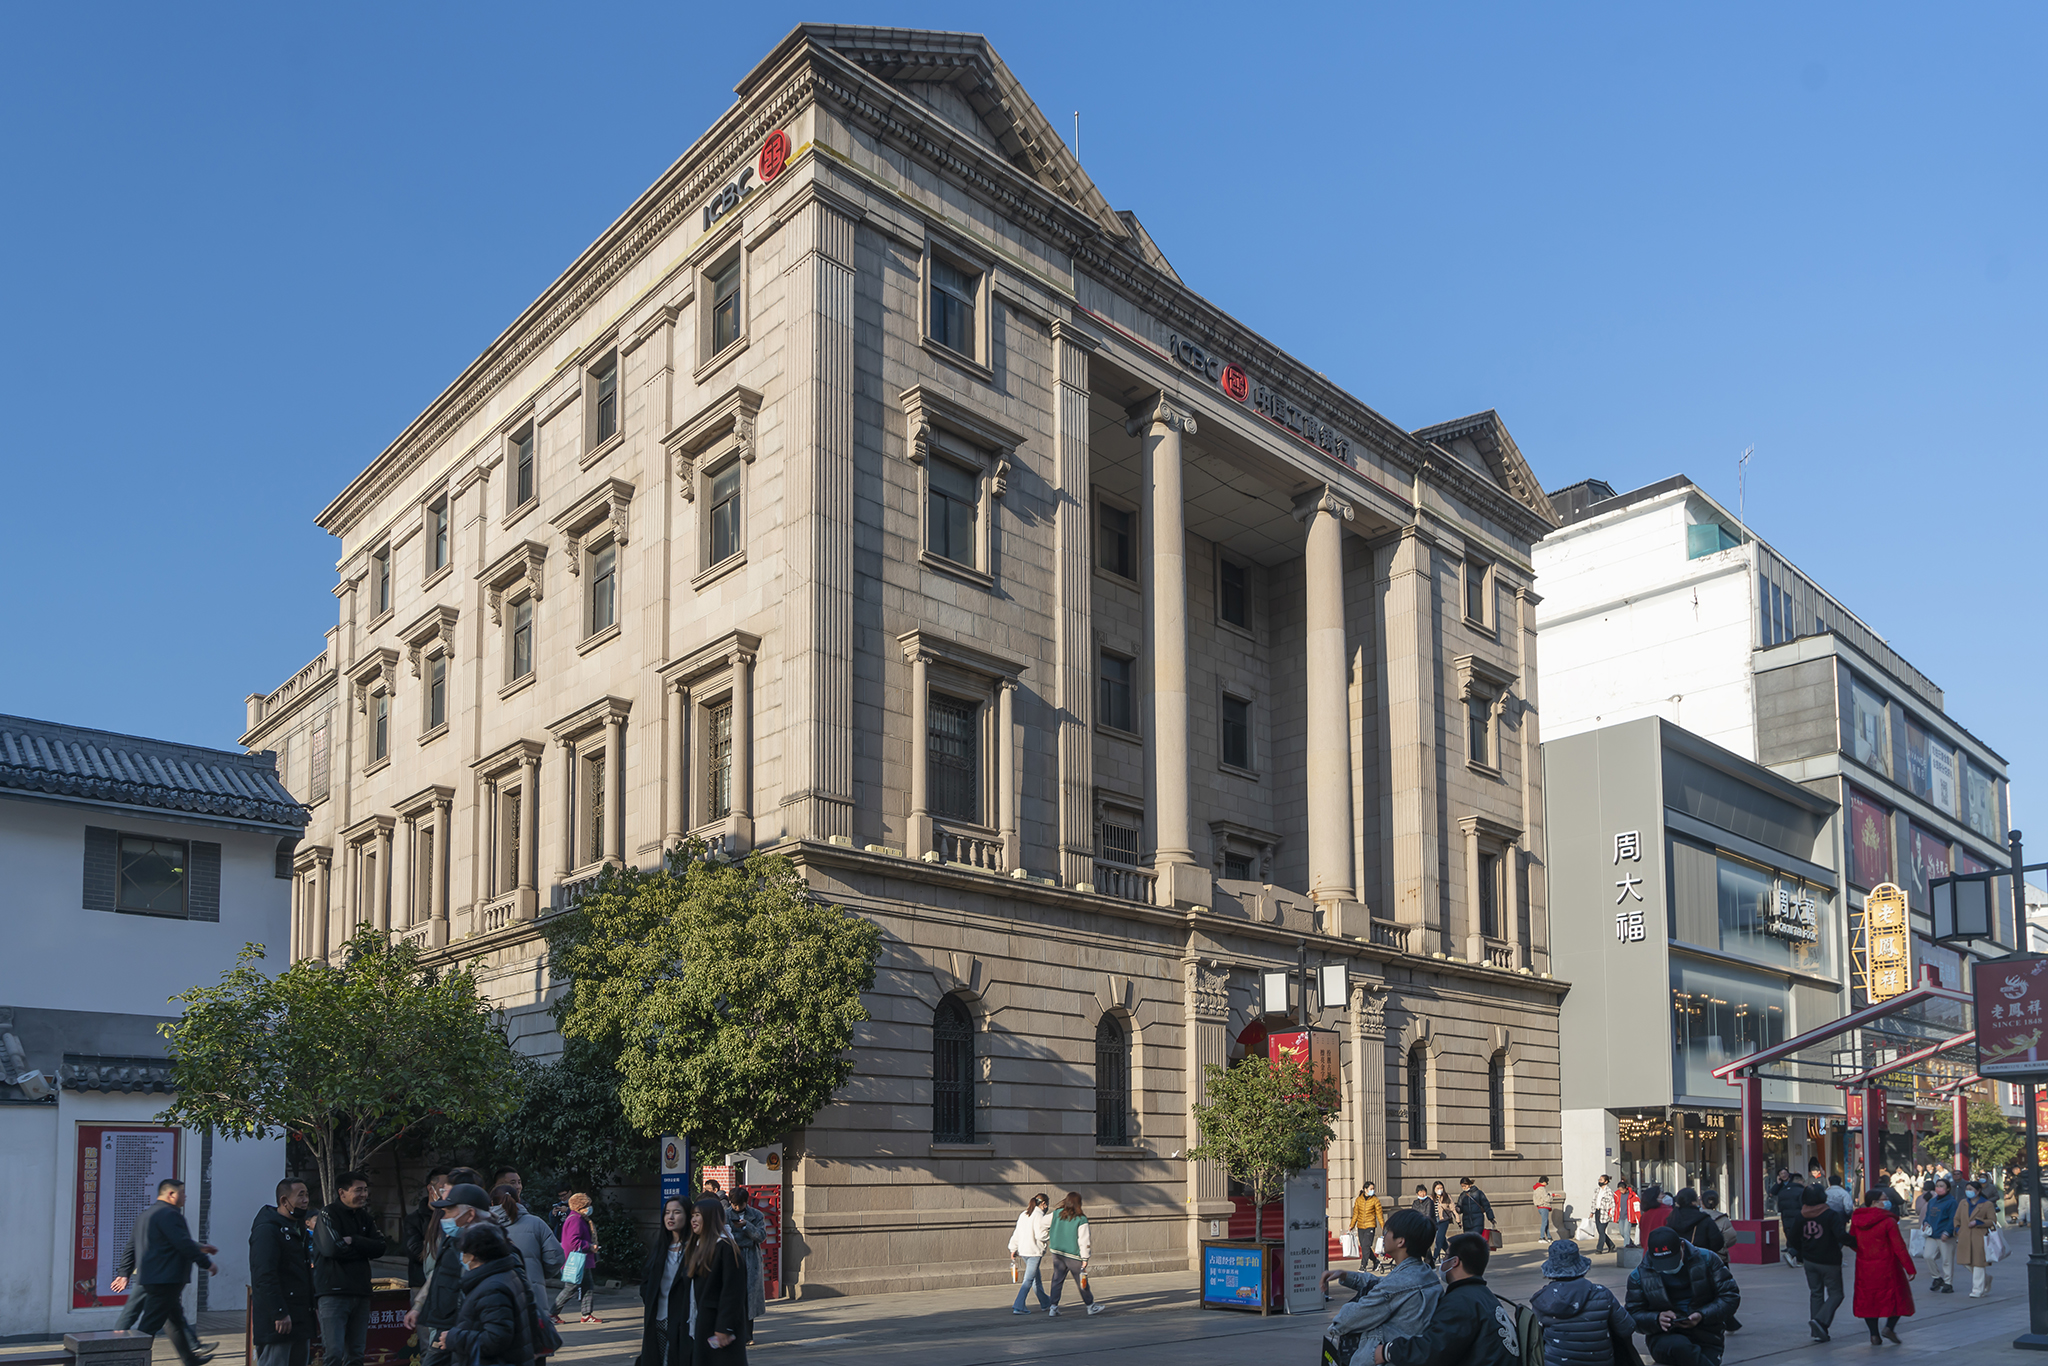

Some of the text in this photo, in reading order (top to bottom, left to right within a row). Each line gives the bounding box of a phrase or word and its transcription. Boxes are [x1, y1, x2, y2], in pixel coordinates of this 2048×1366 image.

[703, 166, 754, 232] ICBC
[1170, 334, 1219, 382] ICBC
[1254, 386, 1350, 461] 中国工商银行
[1613, 830, 1646, 944] 周大福
[1778, 888, 1816, 927] 周大福
[1878, 904, 1899, 992] 老鳳祥
[1991, 999, 2042, 1019] 老鳳祥
[1992, 1018, 2043, 1028] SINCE 1848
[1706, 1114, 1725, 1128] 周大福
